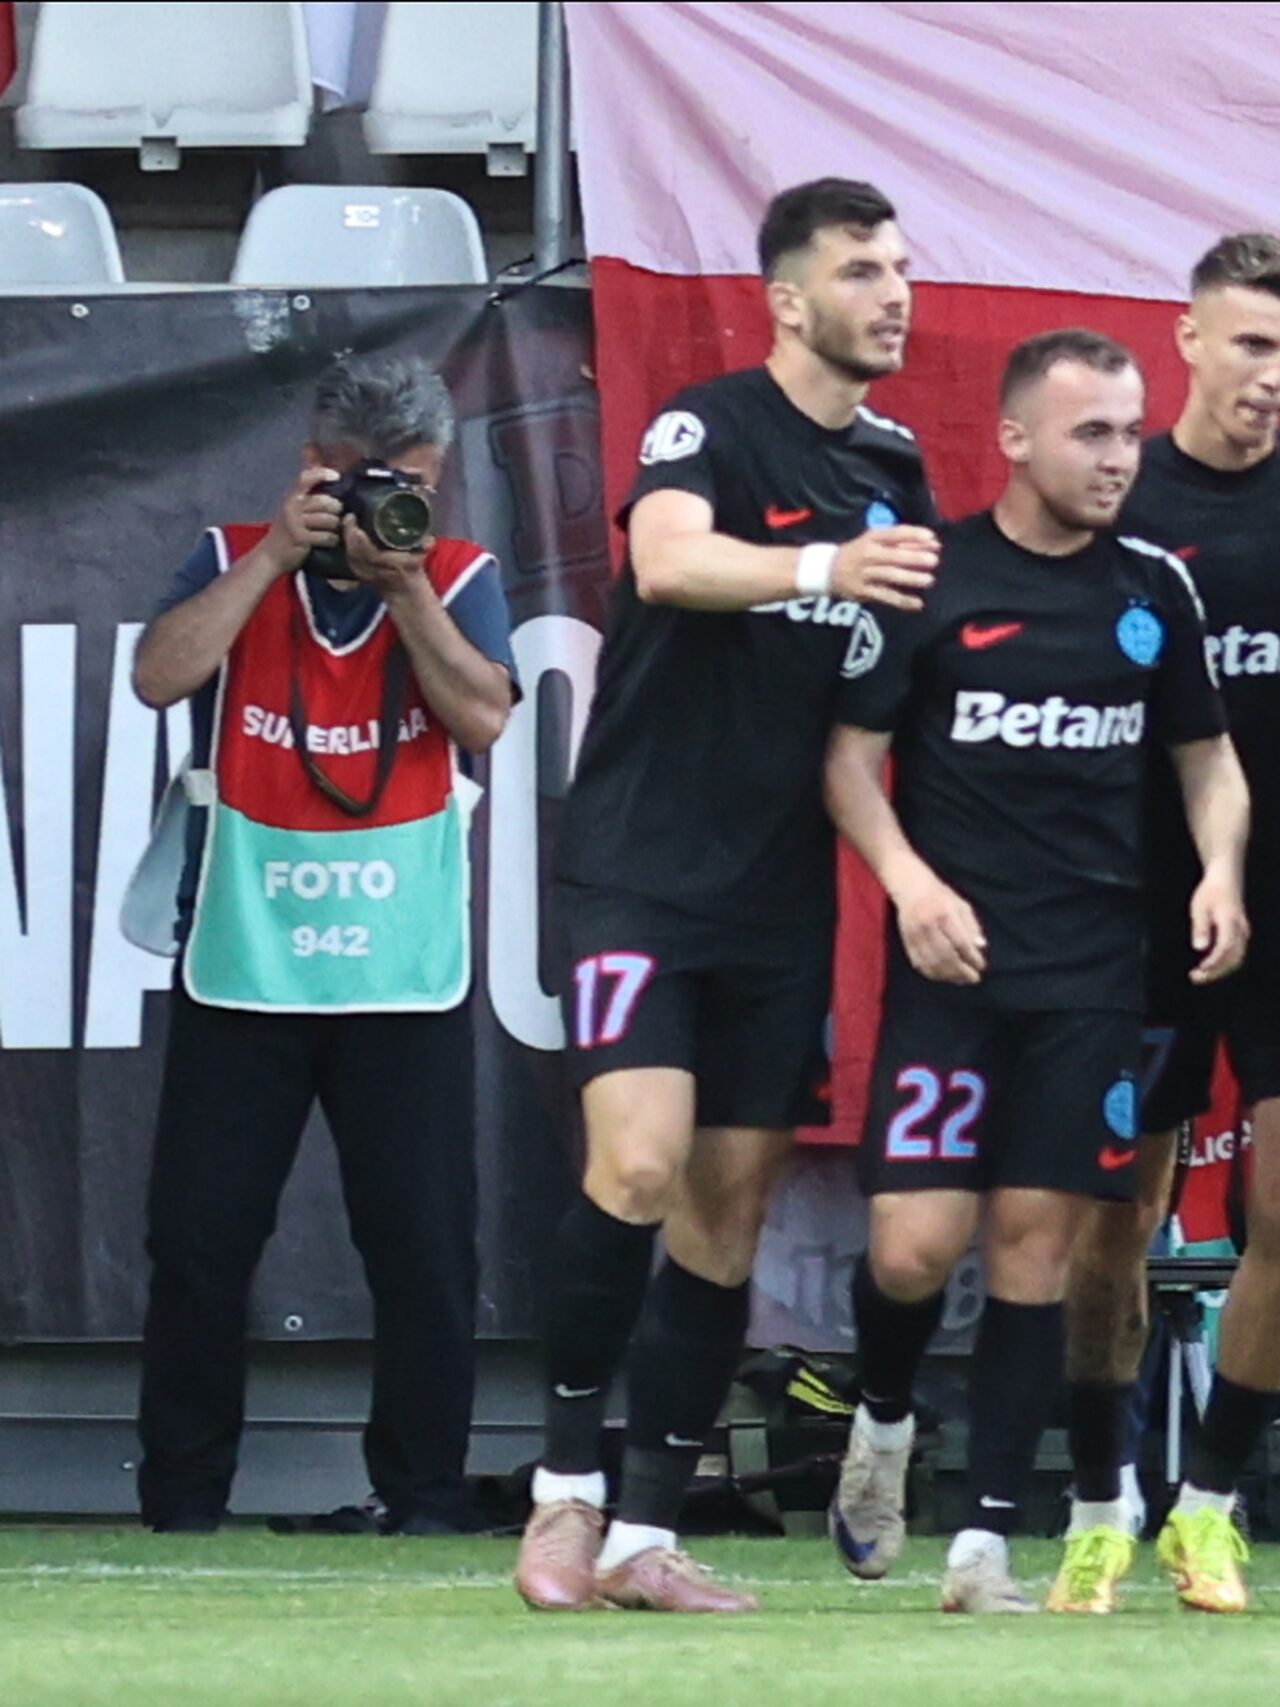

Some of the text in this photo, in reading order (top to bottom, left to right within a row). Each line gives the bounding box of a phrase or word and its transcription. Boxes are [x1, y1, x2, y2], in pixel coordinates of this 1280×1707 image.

[951, 690, 1145, 748] Betano
[264, 859, 397, 900] FOTO
[291, 924, 370, 957] 942
[574, 950, 658, 1049] 17
[884, 1062, 987, 1161] 22
